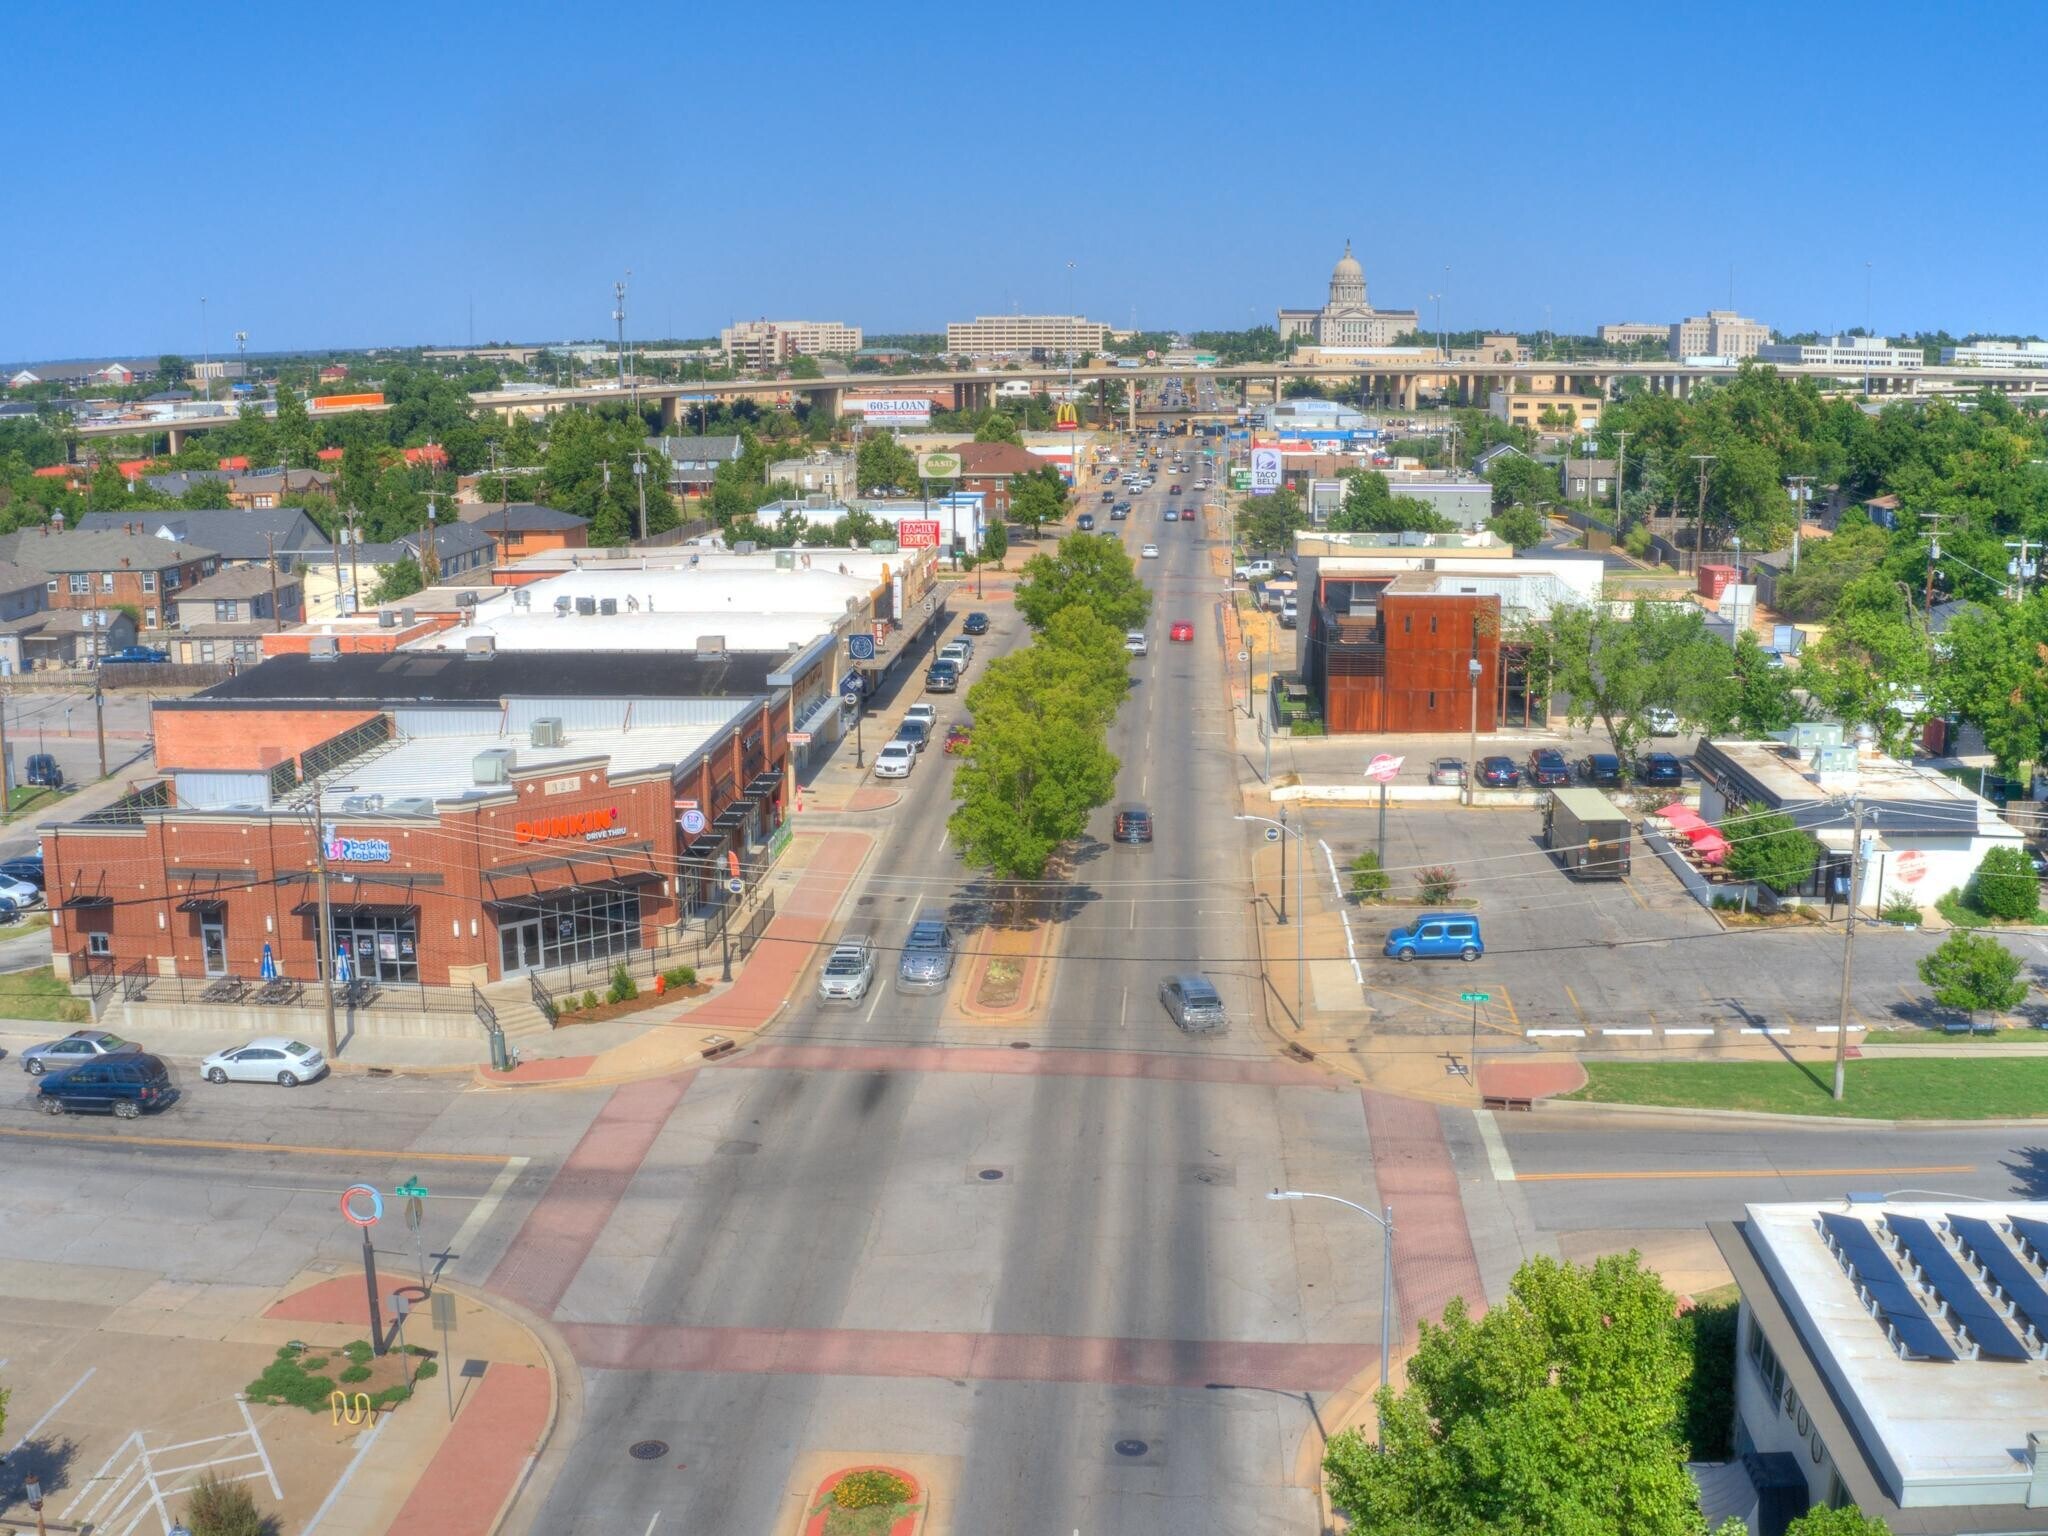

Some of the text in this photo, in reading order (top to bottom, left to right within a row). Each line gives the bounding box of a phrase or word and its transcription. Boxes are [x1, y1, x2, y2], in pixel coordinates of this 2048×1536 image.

[870, 401, 926, 411] 605-LOAN
[904, 524, 936, 533] FAMILY
[515, 806, 618, 845] DUNKIN'
[586, 827, 627, 841] DRIVE THRU
[350, 840, 388, 851] baskin
[351, 850, 389, 860] robbins
[1784, 1386, 1824, 1464] 400
